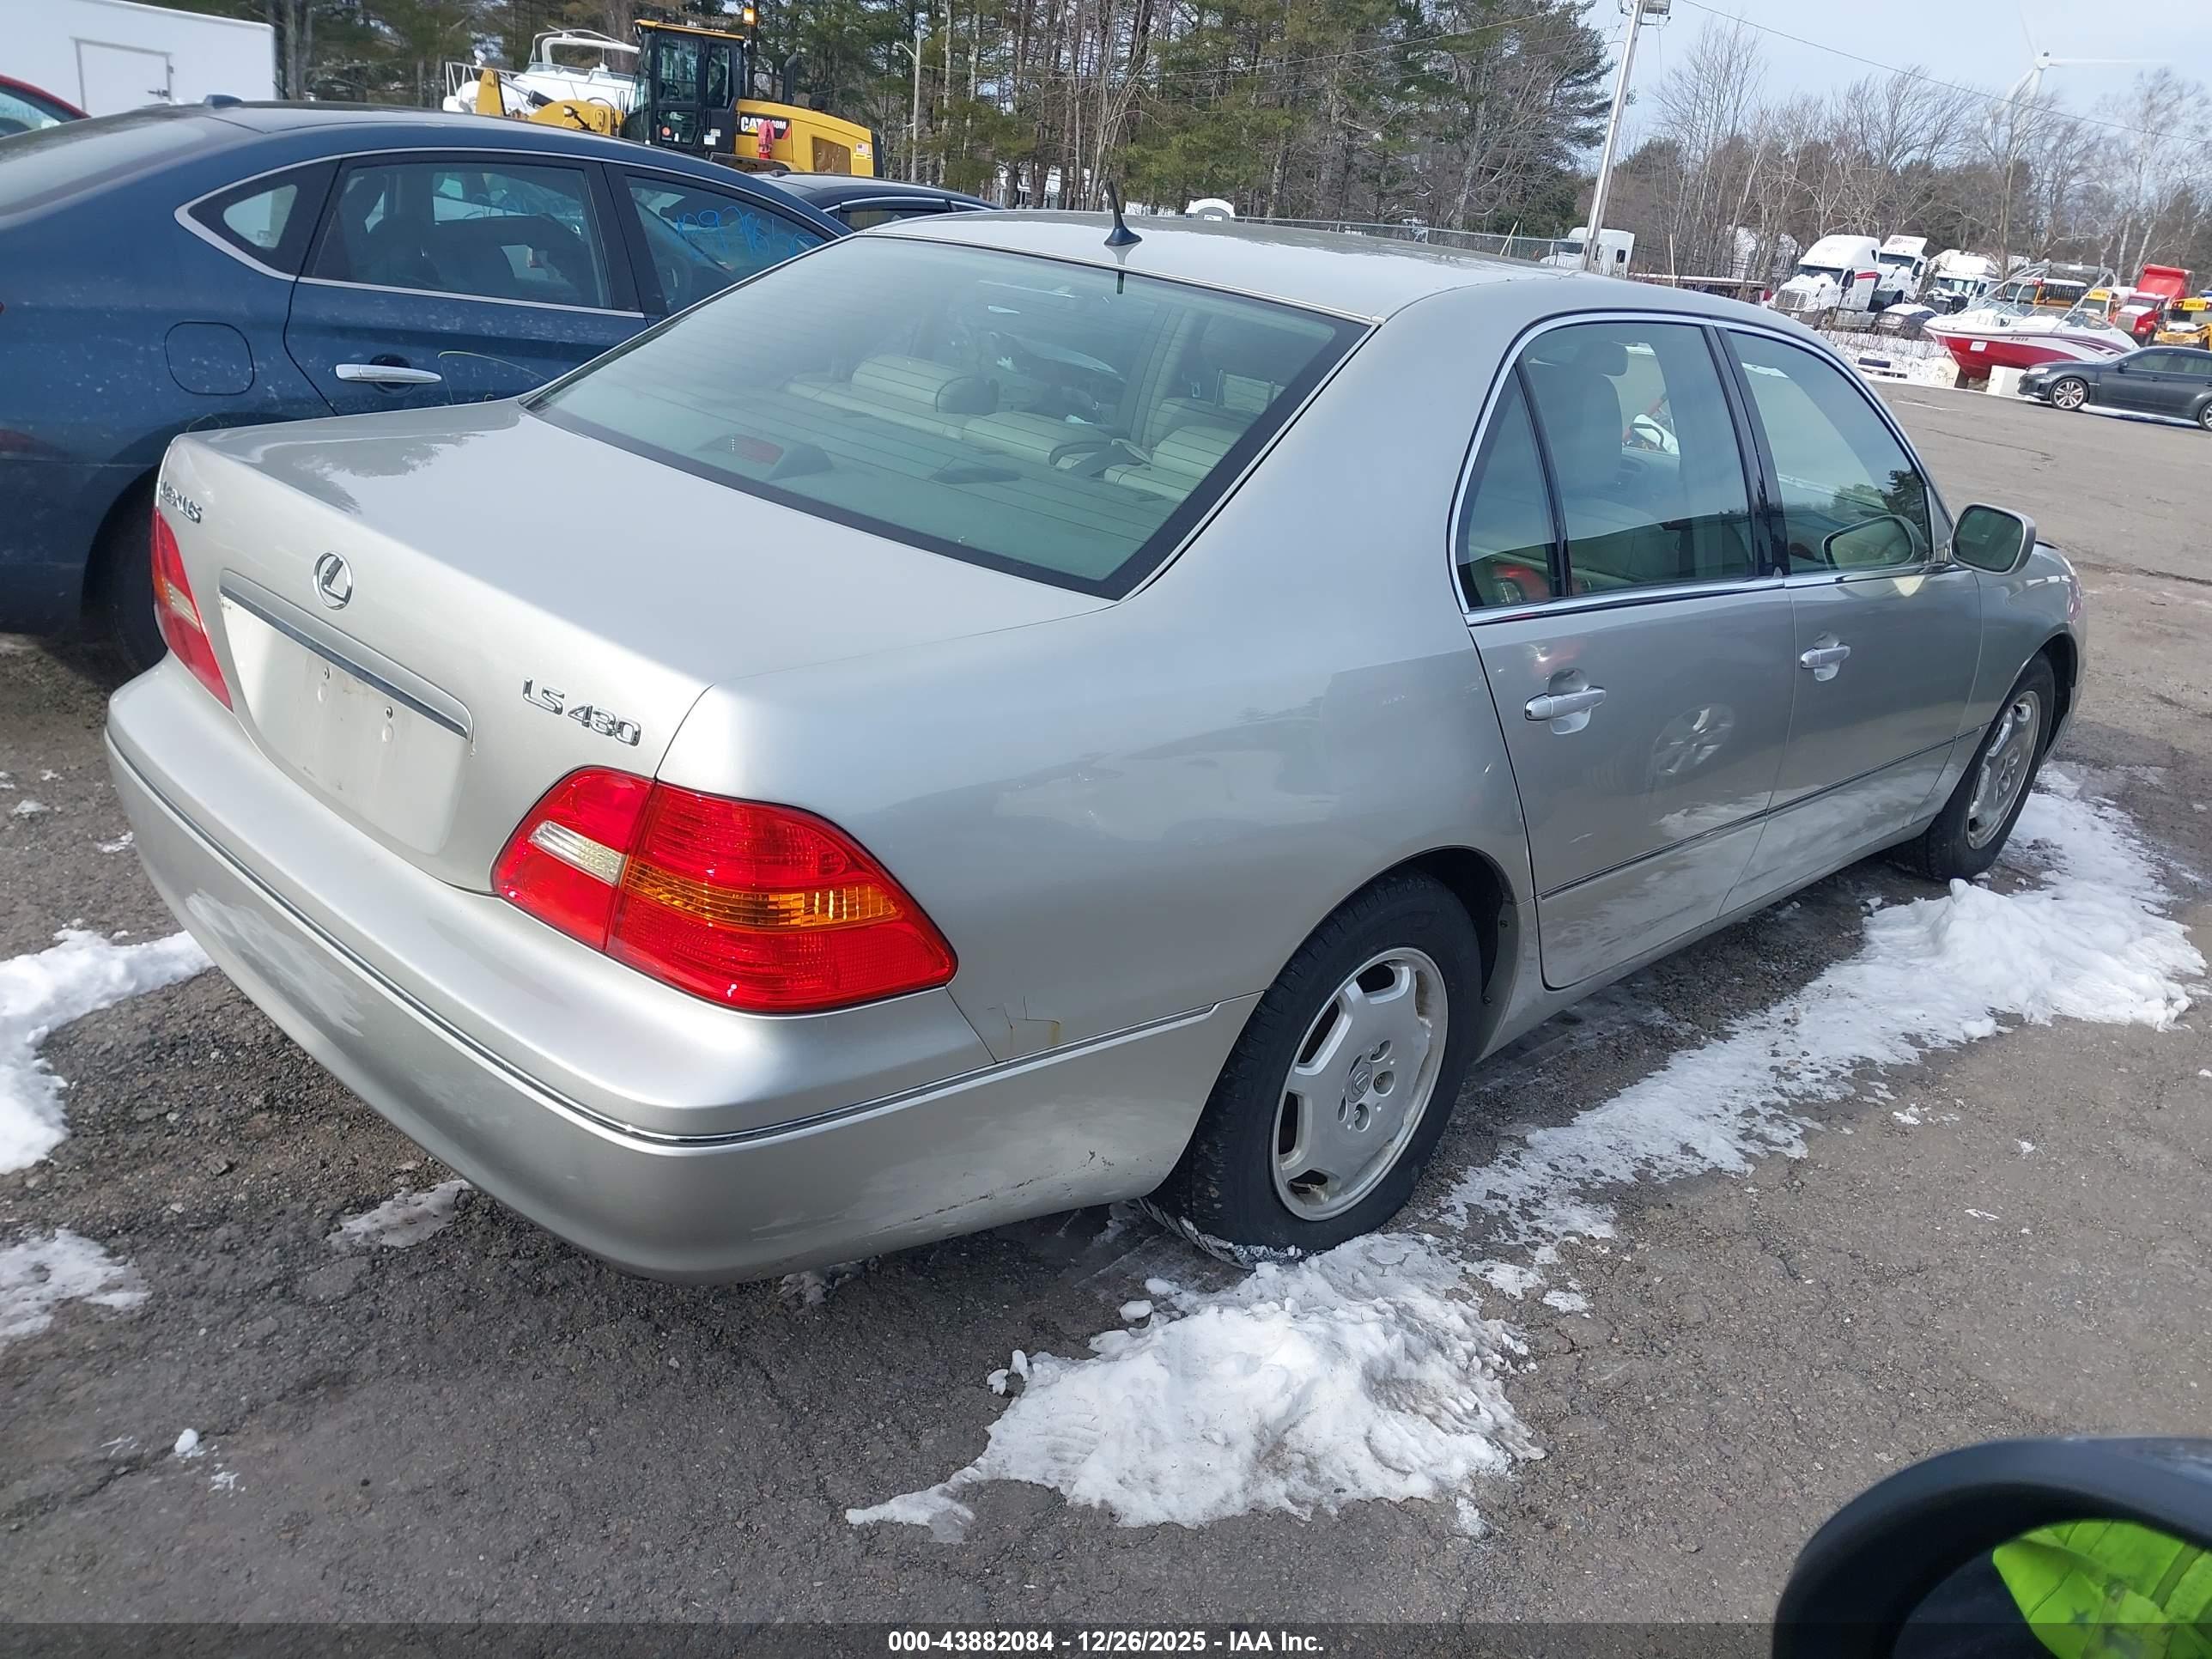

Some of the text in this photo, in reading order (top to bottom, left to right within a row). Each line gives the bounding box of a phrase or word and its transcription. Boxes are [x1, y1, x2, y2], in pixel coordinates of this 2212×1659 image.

[741, 116, 763, 132] CAT
[161, 481, 203, 524] LEXUS
[522, 678, 641, 747] LS 430
